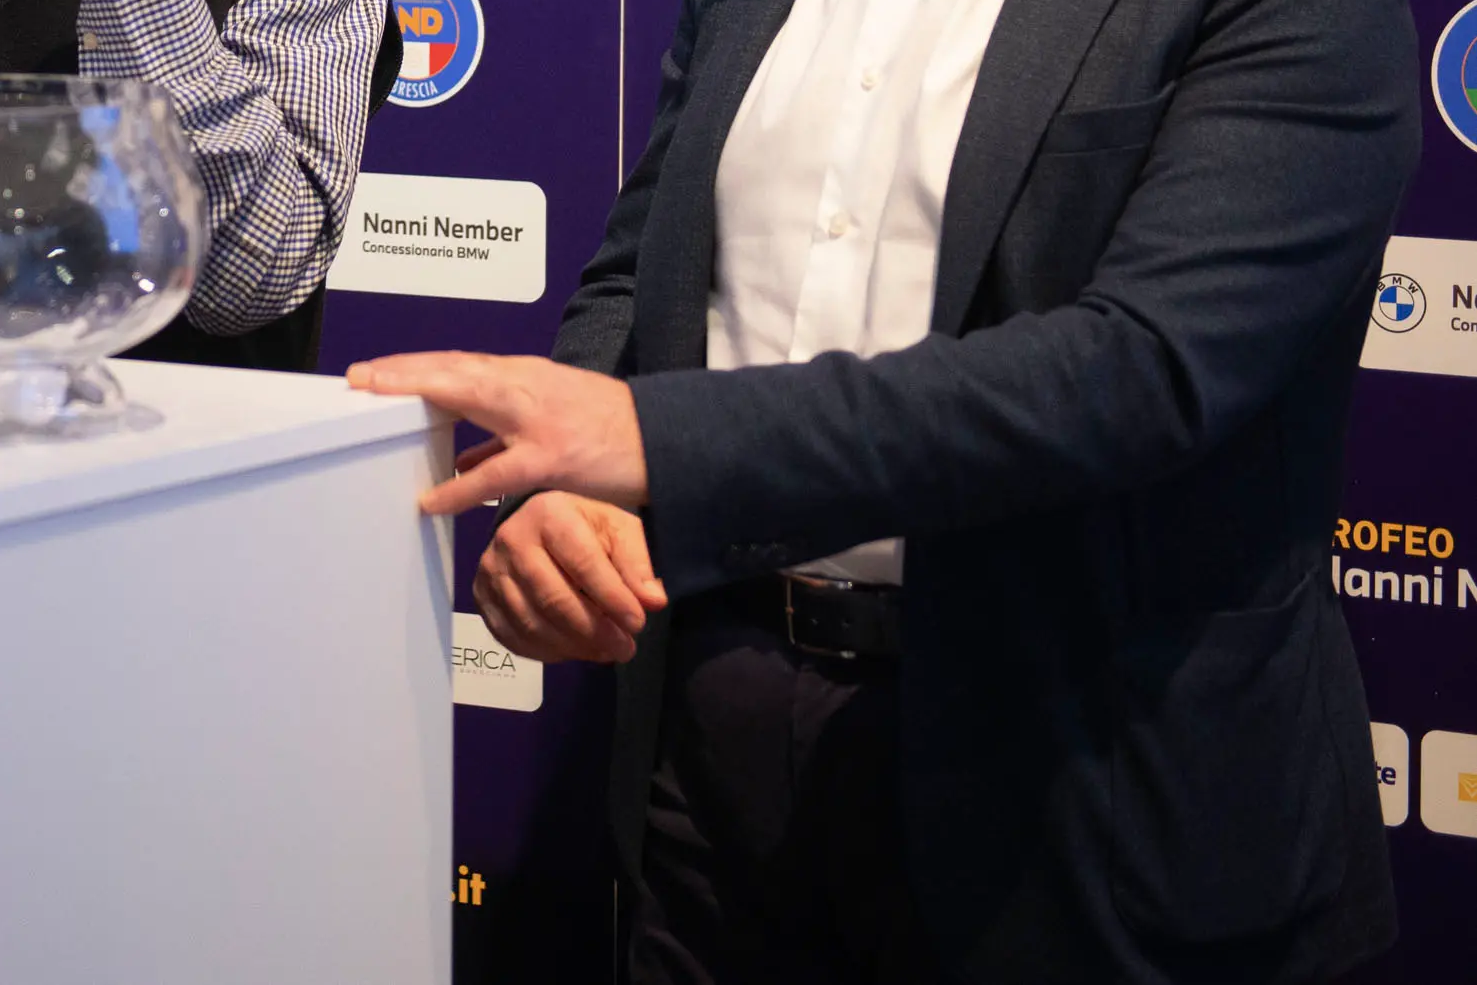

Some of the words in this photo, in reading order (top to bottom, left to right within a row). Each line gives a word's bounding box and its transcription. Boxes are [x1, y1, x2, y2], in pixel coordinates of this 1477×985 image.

[398, 6, 443, 37] ND
[392, 80, 438, 99] BRESCIA
[363, 212, 427, 236] Nanni
[435, 217, 523, 242] Nember
[363, 241, 453, 258] Concessionaria
[457, 247, 489, 260] BMW
[1332, 518, 1454, 559] ROFEO
